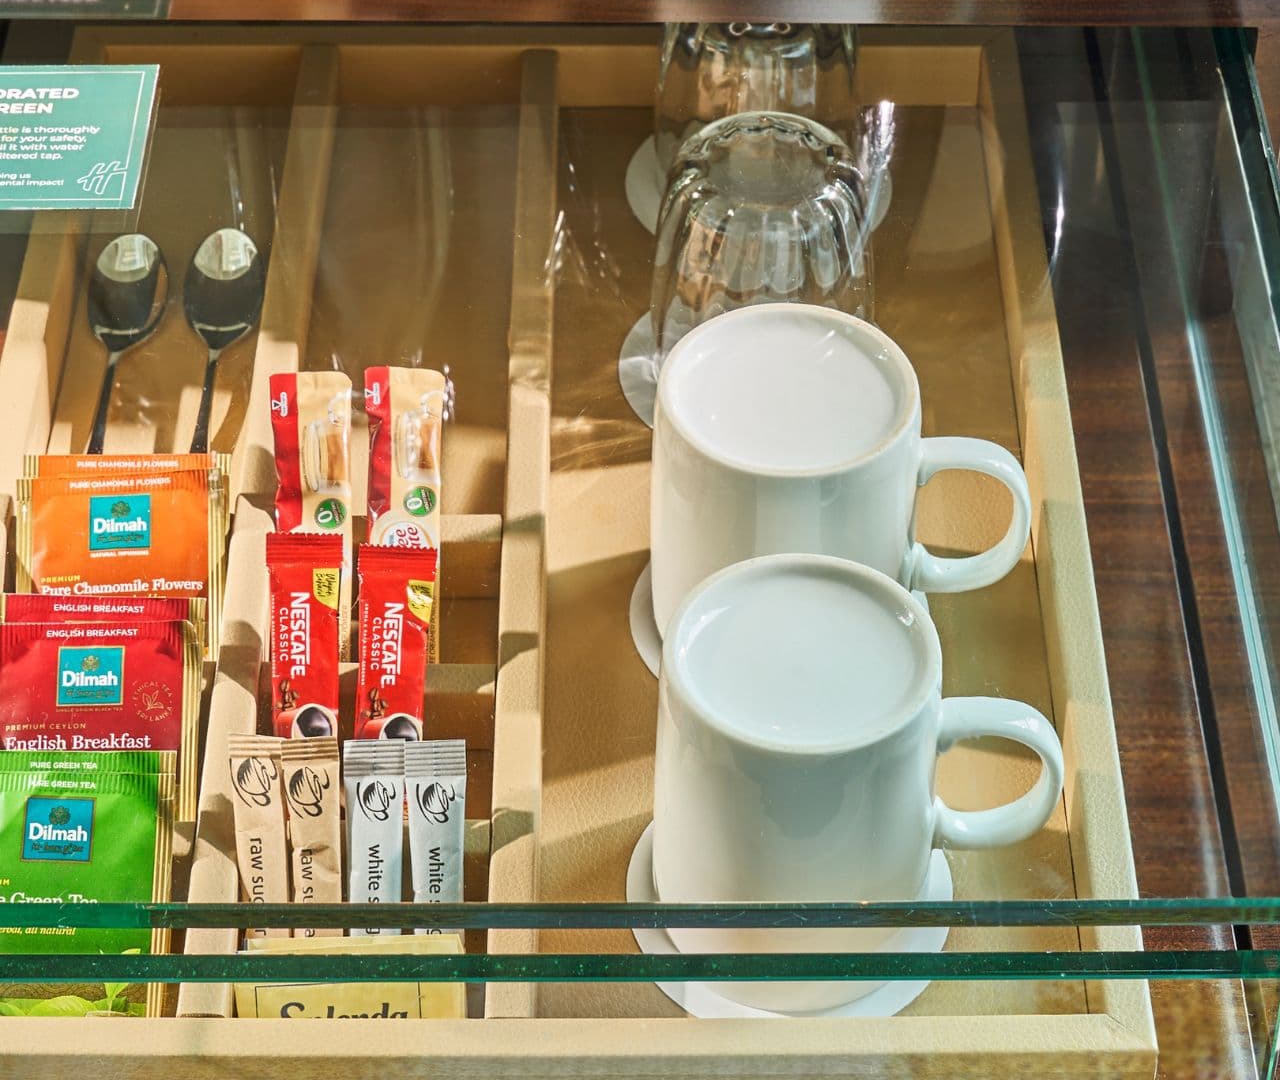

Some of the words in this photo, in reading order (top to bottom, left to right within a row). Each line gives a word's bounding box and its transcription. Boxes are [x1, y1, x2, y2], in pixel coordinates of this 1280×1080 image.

[34, 125, 101, 135] thoroughly
[19, 135, 48, 143] your
[49, 134, 87, 143] safety,
[9, 143, 18, 151] it
[20, 143, 47, 151] with
[50, 143, 84, 151] water
[40, 153, 64, 161] tap.
[26, 179, 65, 187] impact!
[93, 516, 147, 534] Dilmah
[41, 575, 81, 584] PREMIUM
[41, 585, 71, 596] Pure
[73, 579, 149, 595] Chamomile
[152, 578, 204, 591] Flowers
[53, 604, 91, 613] ENGLISH
[92, 604, 144, 613] BREAKFAST
[46, 628, 84, 638] ENGLISH
[86, 628, 139, 637] BREAKFAST
[279, 607, 289, 663] CLASSIC
[370, 616, 382, 671] CLASSIC
[62, 670, 119, 687] Dilmah
[161, 683, 173, 697] TEA
[5, 723, 46, 732] PREMIUM
[49, 722, 87, 730] CEYLON
[5, 735, 66, 751] English
[72, 733, 151, 750] Breakfast
[30, 761, 52, 769] PURE
[52, 761, 80, 769] GREEN
[51, 780, 79, 789] GREEN
[79, 781, 97, 789] TEA
[28, 822, 88, 842] Dilmah
[249, 837, 264, 871] raw
[300, 848, 313, 881] raw
[368, 844, 384, 891] white
[428, 846, 446, 894] white
[40, 927, 77, 936] natural
